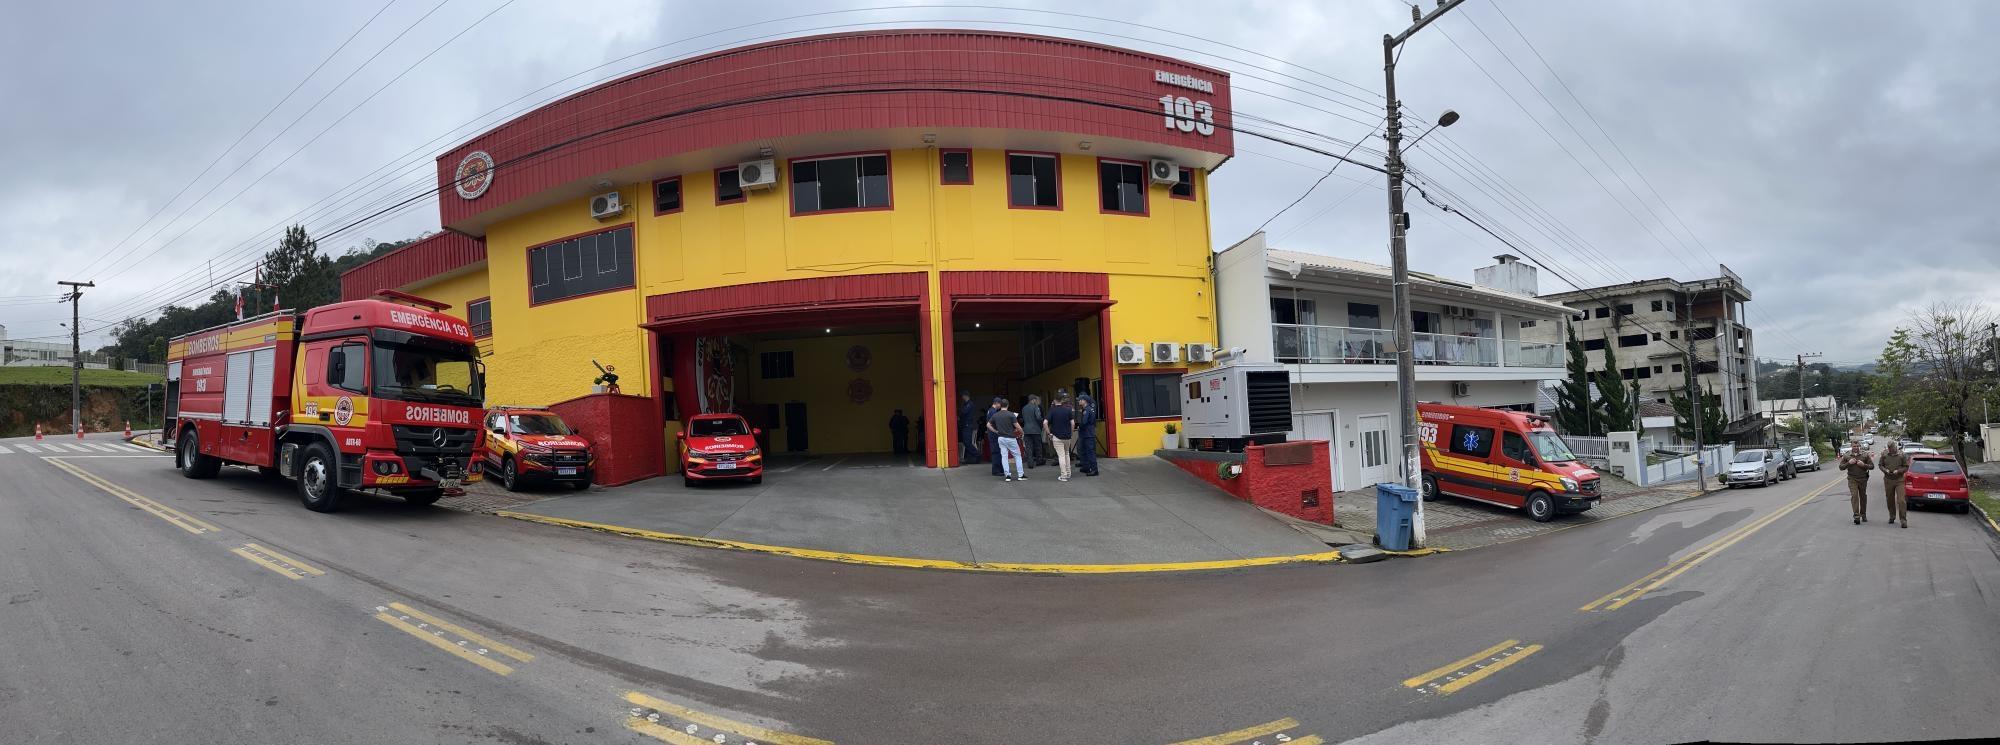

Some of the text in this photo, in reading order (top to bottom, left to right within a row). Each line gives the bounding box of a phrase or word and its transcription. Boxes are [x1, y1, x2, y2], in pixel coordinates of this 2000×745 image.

[1155, 69, 1213, 94] EMERGÊNCIA
[1159, 94, 1215, 136] 193
[390, 310, 469, 338] EMERGÊNCIA 193
[188, 334, 219, 356] BOMBEIROS
[196, 378, 207, 393] 193
[305, 406, 318, 418] 193
